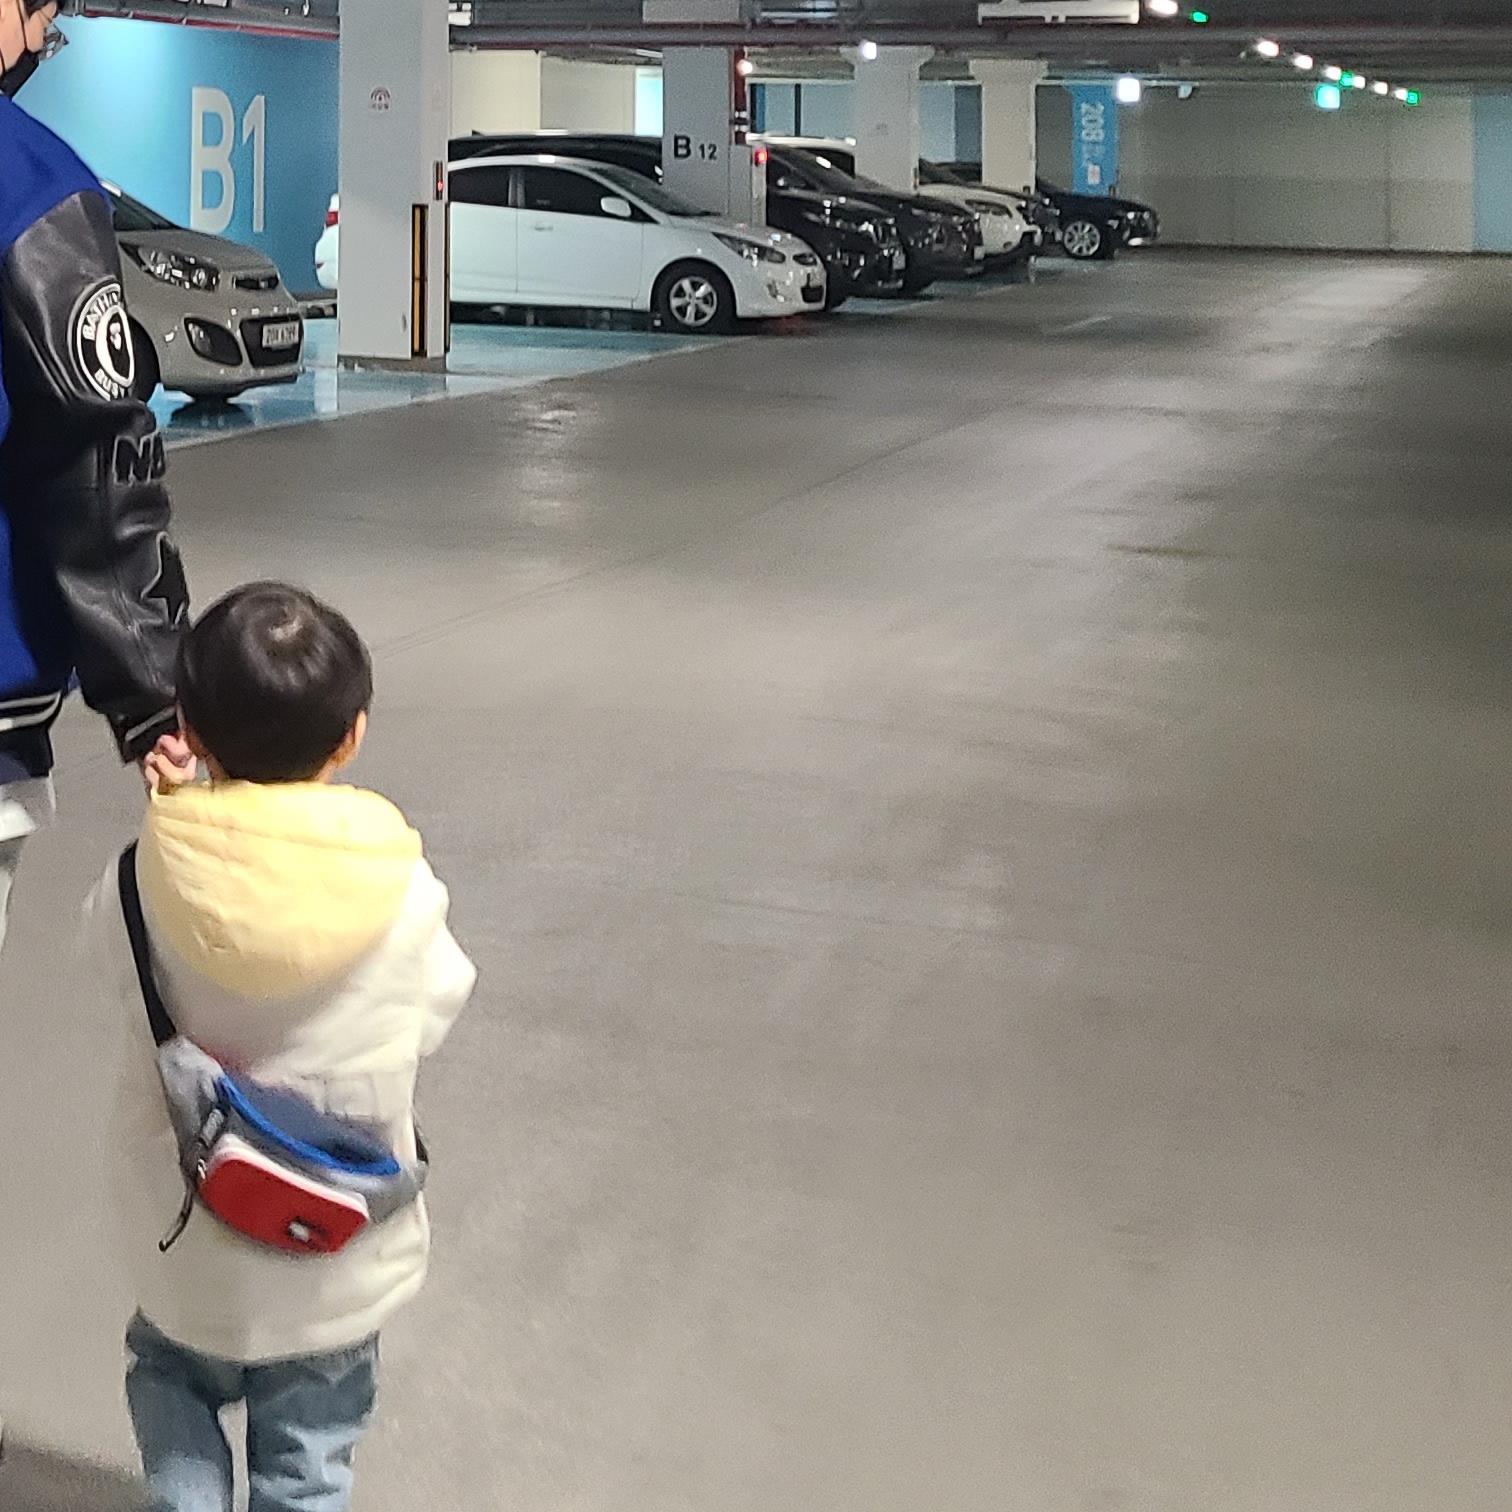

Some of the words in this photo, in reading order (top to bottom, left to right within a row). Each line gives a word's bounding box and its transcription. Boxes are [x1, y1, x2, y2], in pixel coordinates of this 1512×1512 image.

[190, 86, 265, 235] B1
[674, 134, 691, 159] B
[699, 143, 717, 160] 12
